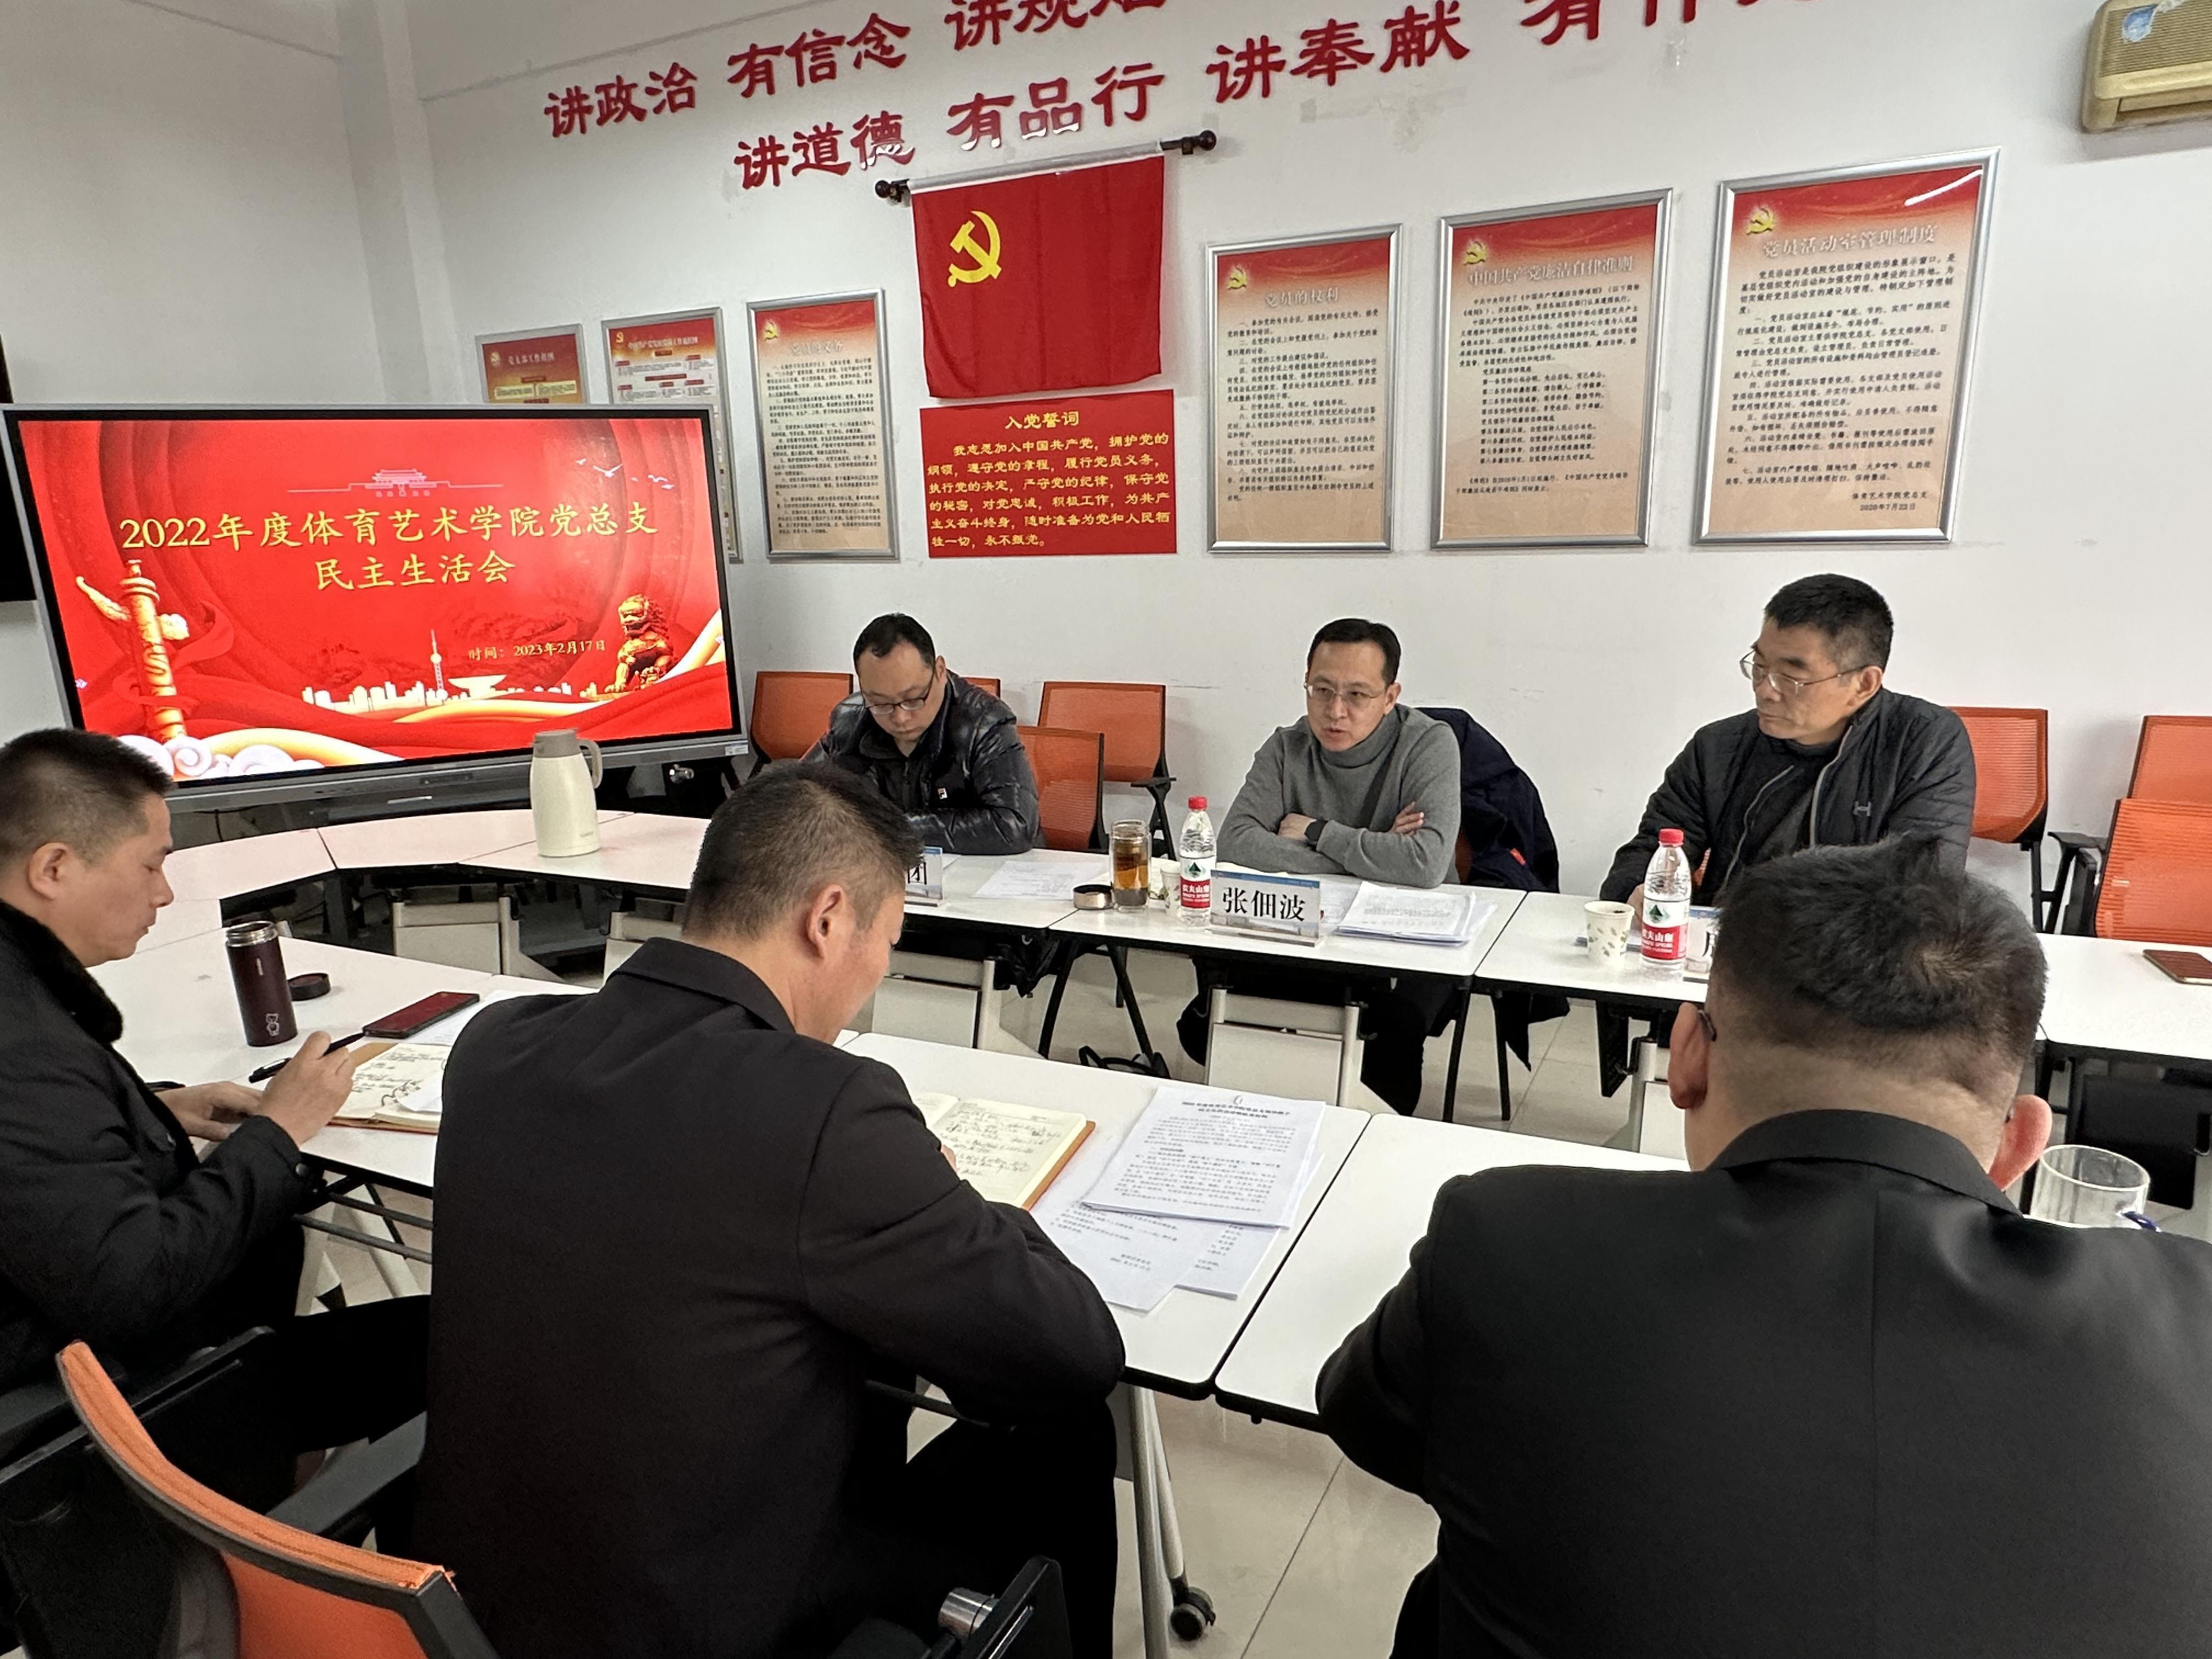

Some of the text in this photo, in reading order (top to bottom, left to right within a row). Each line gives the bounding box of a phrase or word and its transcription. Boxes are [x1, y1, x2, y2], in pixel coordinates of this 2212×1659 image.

[544, 63, 697, 137] 讲政治
[727, 13, 911, 98] 有信念
[733, 112, 916, 190] 讲道德
[947, 63, 1165, 152] 有品行
[1206, 0, 1470, 103] 讲奉献
[1763, 224, 1939, 258] 党员活动室管理制度
[1265, 287, 1339, 307] 党员的权利
[1005, 411, 1080, 430] 入党誓词
[119, 501, 658, 550] 2022年度体育艺术学院党总支
[316, 550, 516, 591] 民主生活会
[1223, 887, 1305, 922] 张佃波
